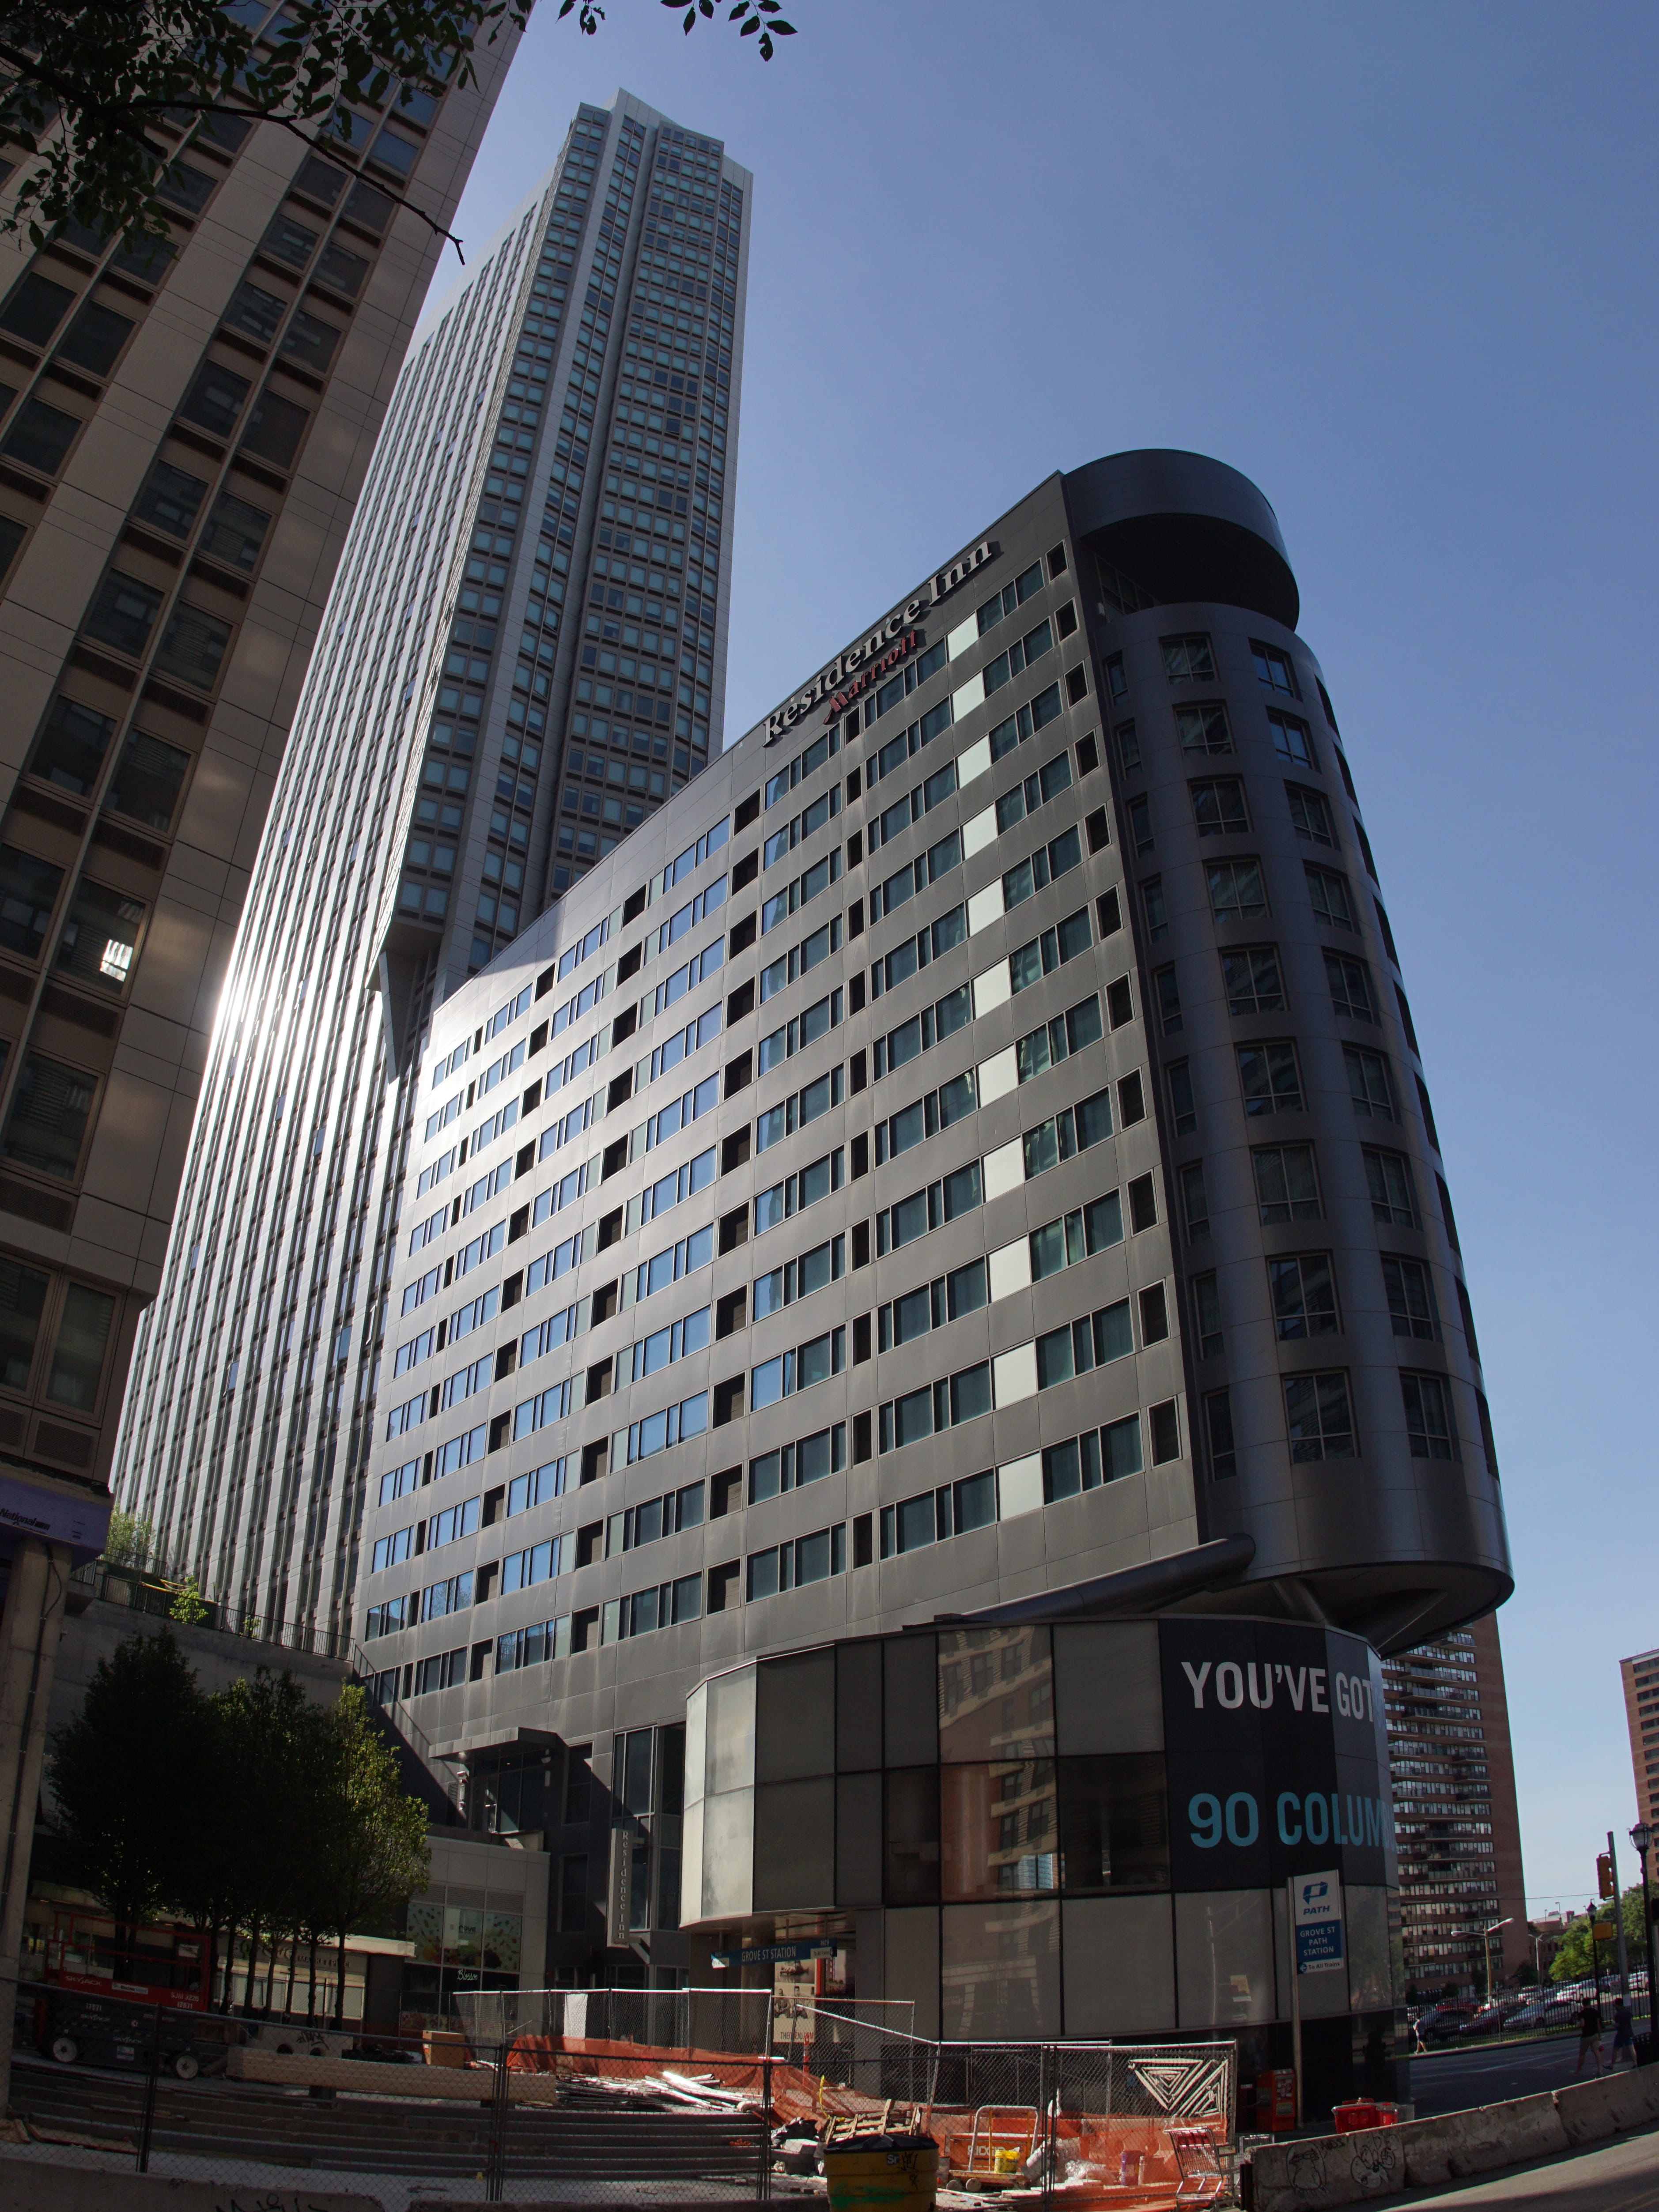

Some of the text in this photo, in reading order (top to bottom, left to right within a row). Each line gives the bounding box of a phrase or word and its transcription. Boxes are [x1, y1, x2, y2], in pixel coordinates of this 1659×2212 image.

[763, 541, 992, 747] Residence Inn
[824, 629, 917, 725] Marriott
[0, 1508, 37, 1526] National
[1181, 1661, 1329, 1713] YOU'VE
[1335, 1672, 1373, 1722] GOT
[1188, 1792, 1259, 1849] 90
[620, 1831, 628, 1910] Residence
[1303, 1905, 1330, 1916] PATH
[1300, 1927, 1325, 1937] GROVE
[1308, 1937, 1328, 1946] PATH
[741, 1946, 796, 1962] GROVE ST STATION
[1303, 1946, 1334, 1956] STATION
[65, 1975, 102, 1986] SKYJACK
